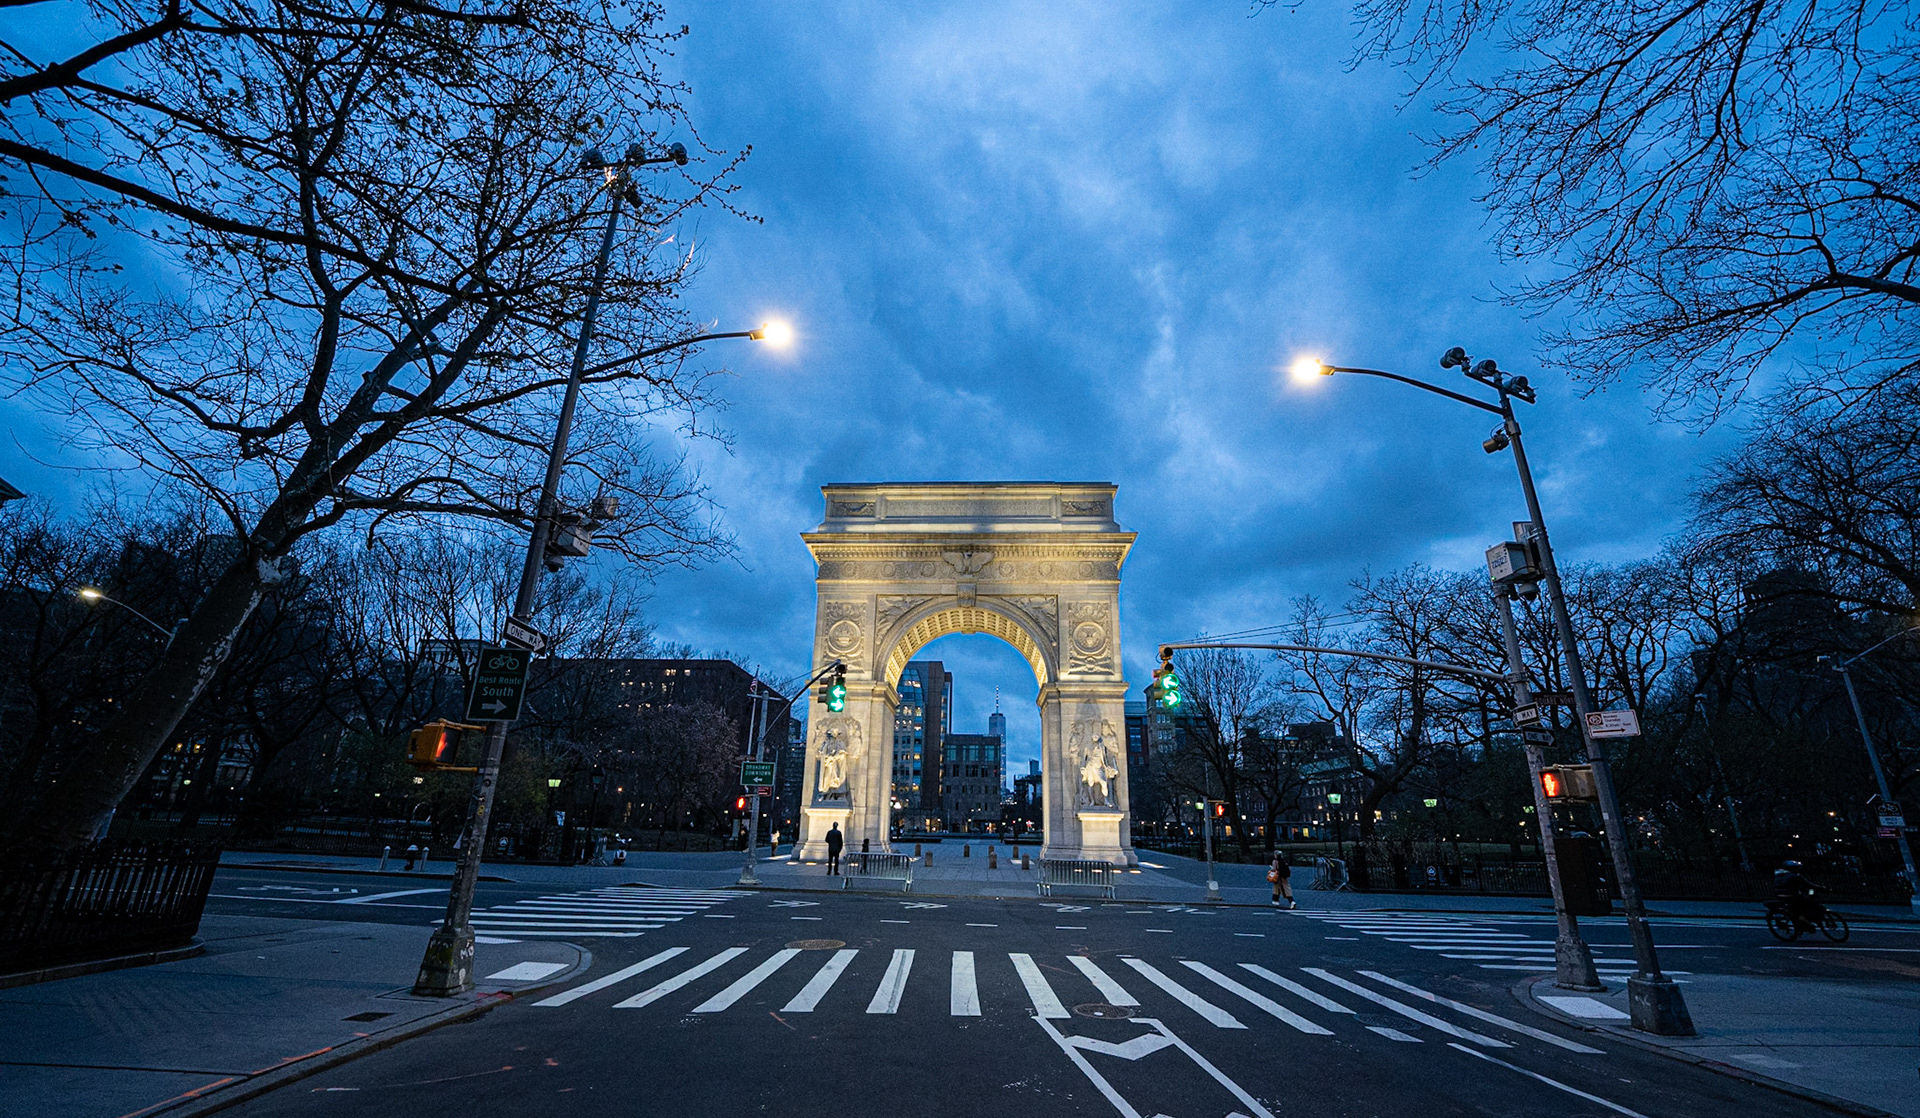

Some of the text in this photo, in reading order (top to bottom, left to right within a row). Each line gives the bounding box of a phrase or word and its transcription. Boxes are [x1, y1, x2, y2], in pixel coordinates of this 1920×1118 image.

[511, 626, 542, 646] ONE WAY
[478, 675, 523, 685] Best Route
[481, 686, 514, 697] South
[1521, 710, 1534, 718] WAY
